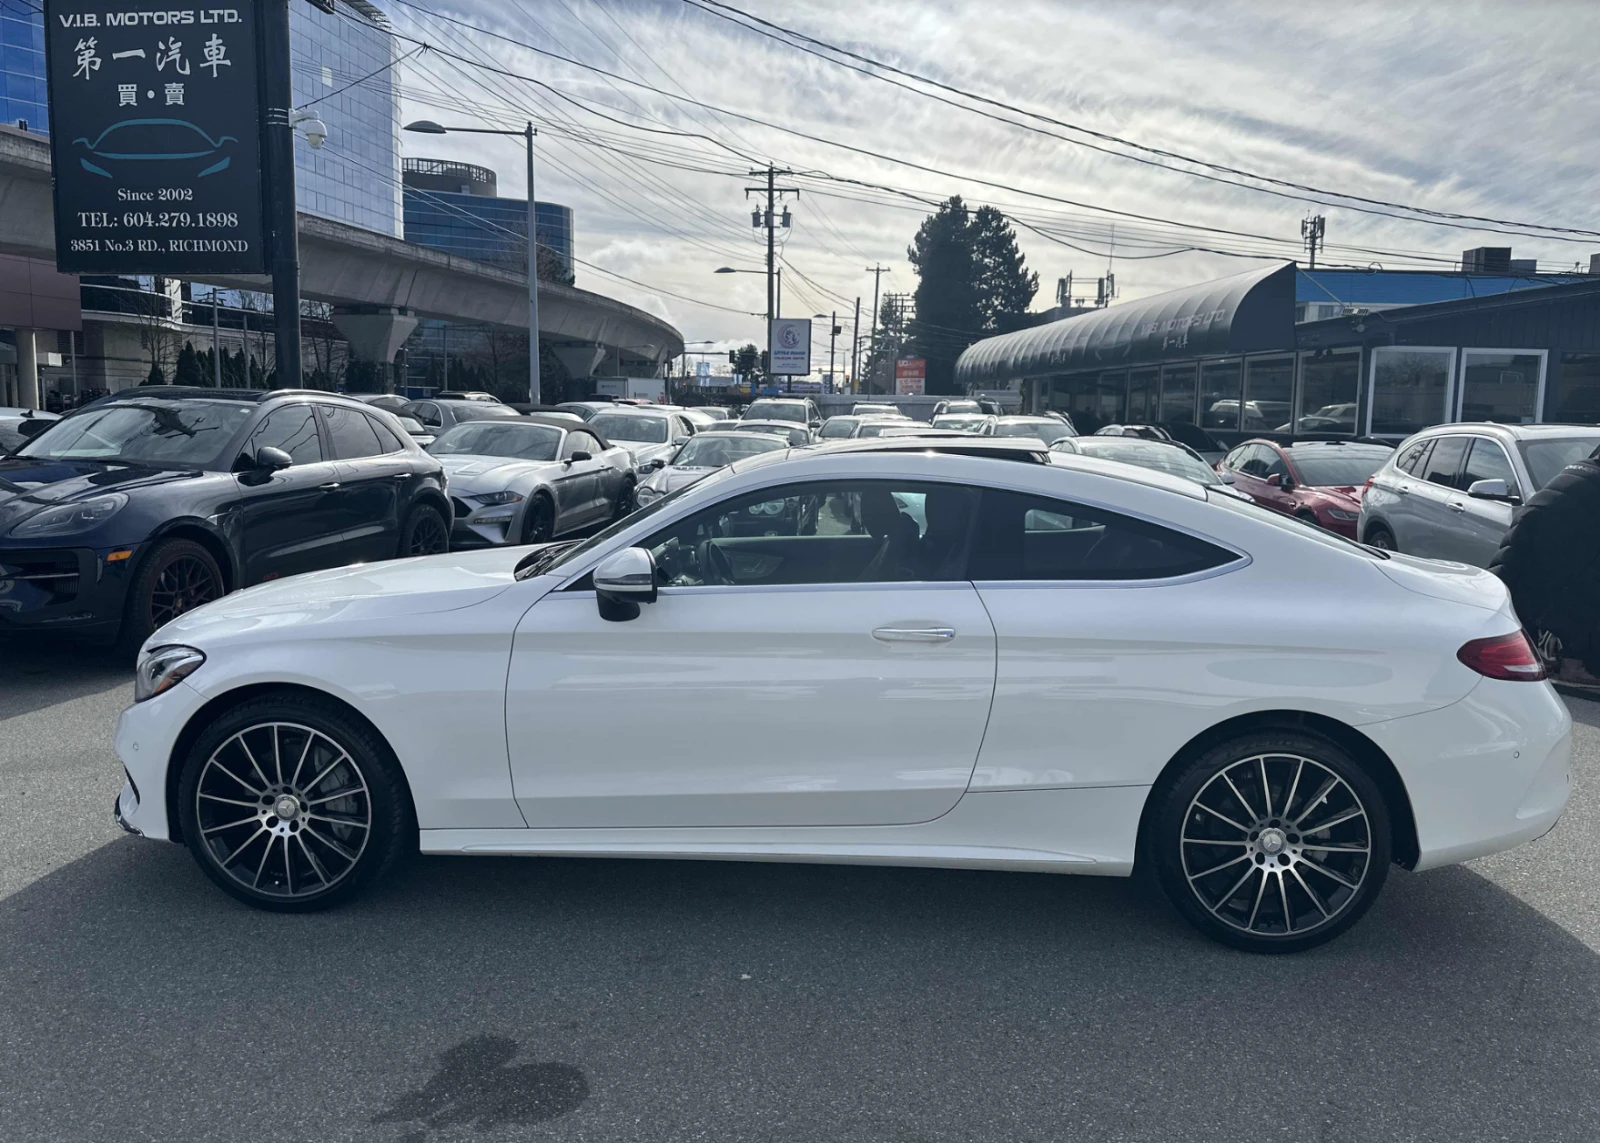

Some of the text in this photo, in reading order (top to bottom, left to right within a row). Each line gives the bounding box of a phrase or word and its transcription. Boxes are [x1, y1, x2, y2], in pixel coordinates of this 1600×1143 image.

[59, 10, 242, 27] V.I.B. MOTORS LTD.
[73, 33, 231, 80] 第一汽車
[118, 188, 192, 200] Since 2002
[78, 212, 238, 227] TEL: 604.279.1898
[71, 240, 99, 251] 3851
[105, 240, 133, 251] No.3
[169, 240, 248, 251] RICHMOND
